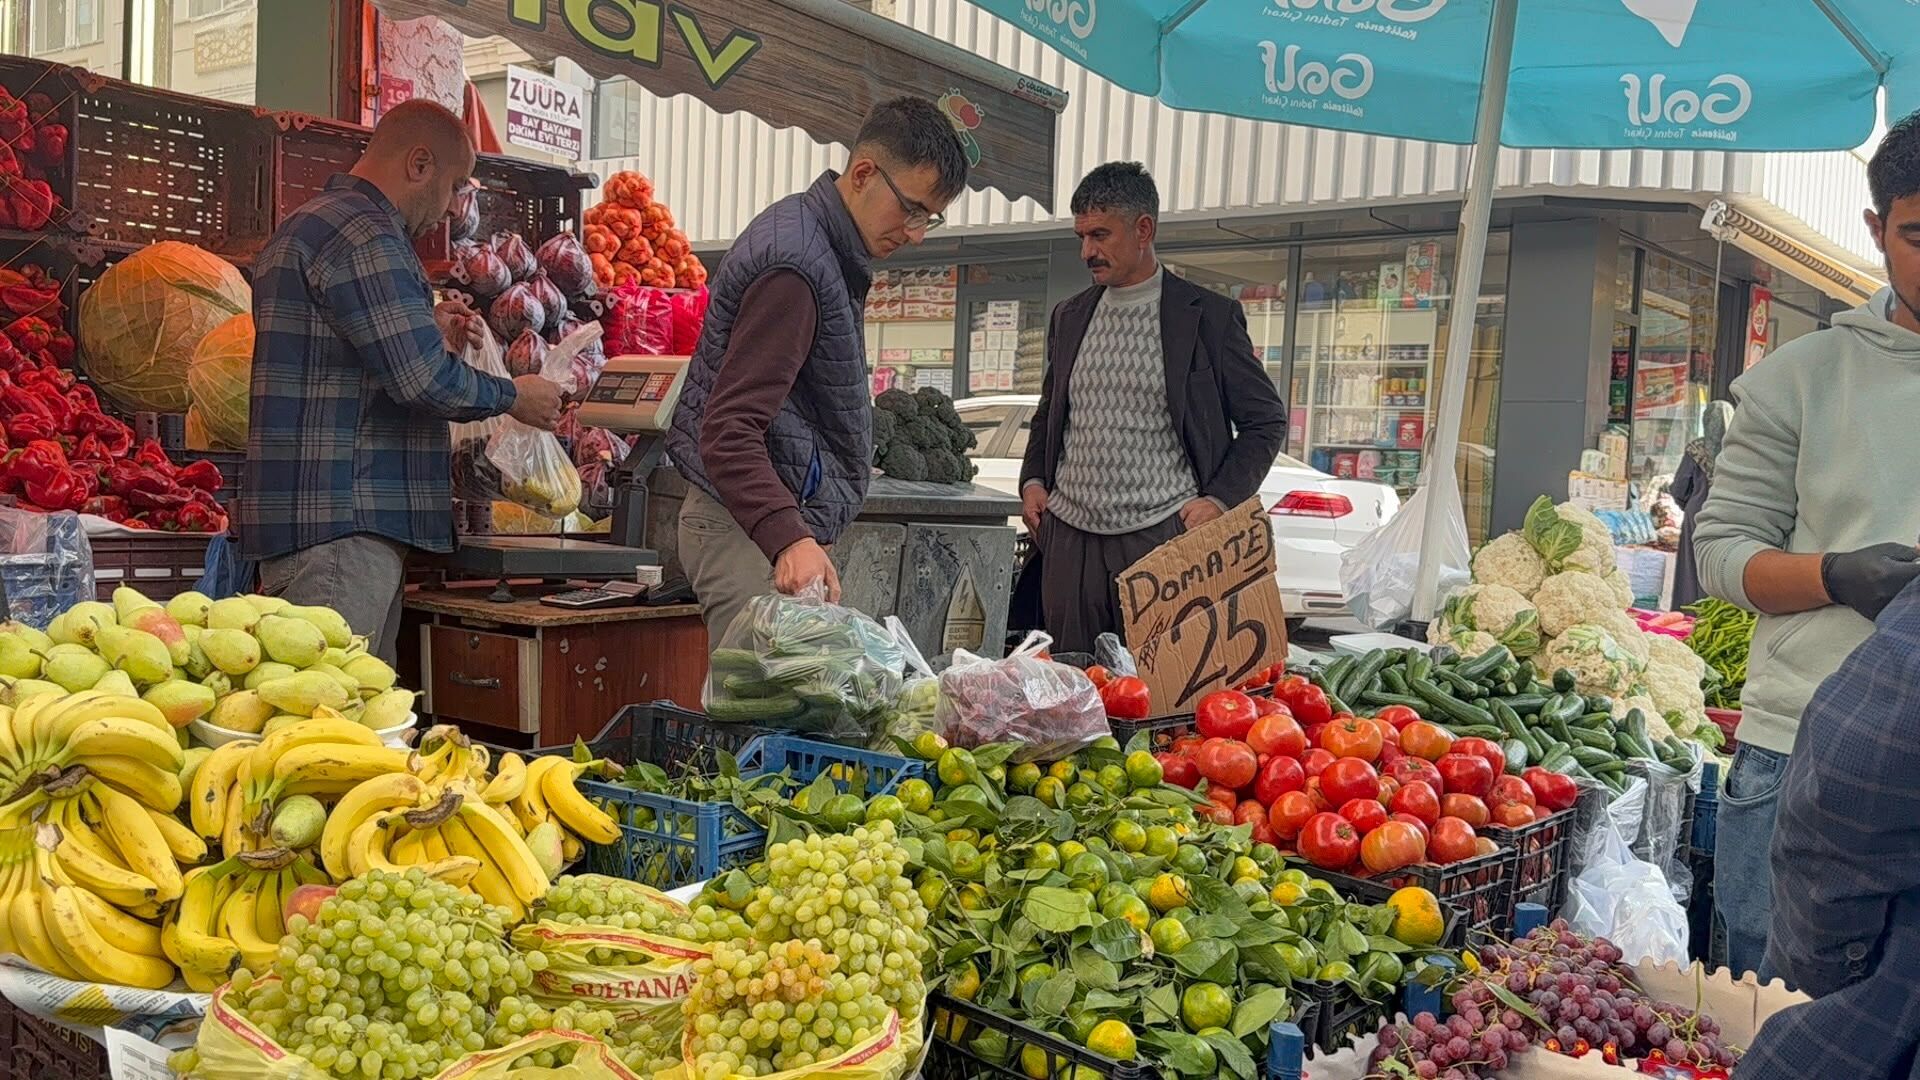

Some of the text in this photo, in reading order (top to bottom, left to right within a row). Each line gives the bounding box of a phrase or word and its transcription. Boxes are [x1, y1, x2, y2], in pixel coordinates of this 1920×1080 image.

[521, 115, 571, 138] BAY BAYAN
[1171, 567, 1268, 708] 25
